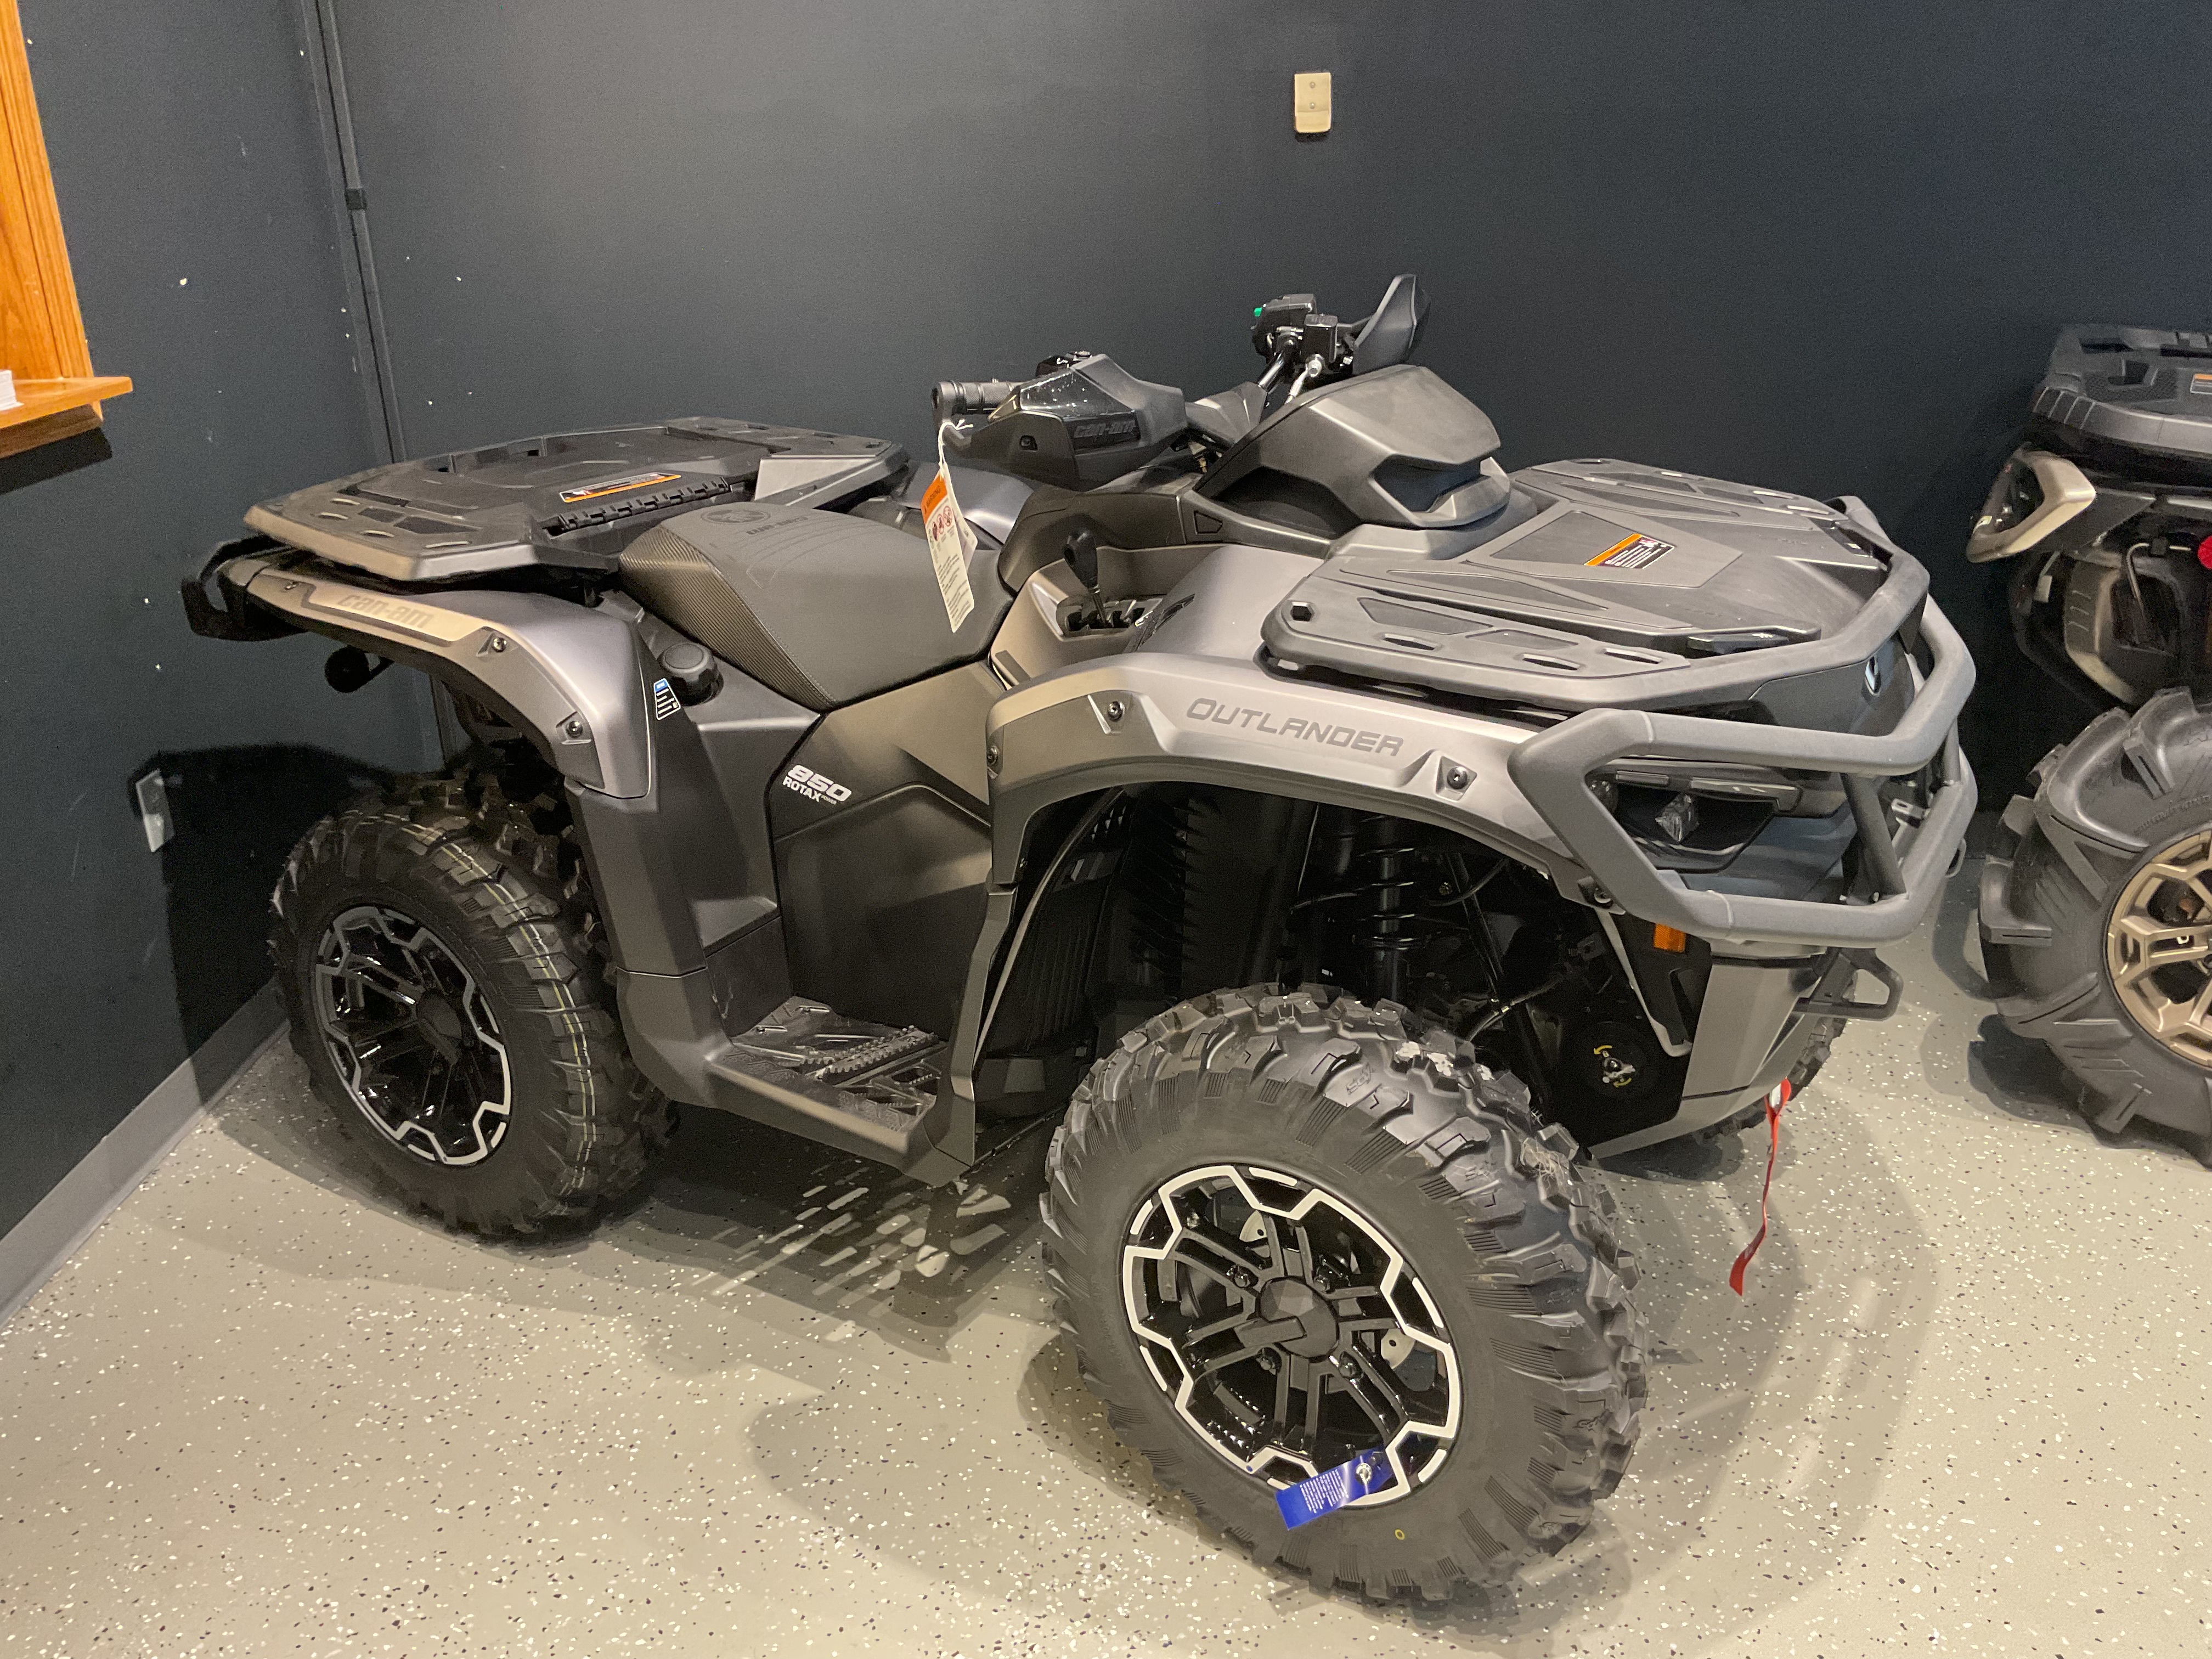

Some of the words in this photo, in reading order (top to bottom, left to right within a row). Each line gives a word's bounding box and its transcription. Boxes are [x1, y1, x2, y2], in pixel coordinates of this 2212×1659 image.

[337, 595, 434, 629] can-am
[1186, 698, 1404, 757] OUTLANDER
[782, 776, 822, 803] ROTAX
[788, 765, 852, 802] 850
